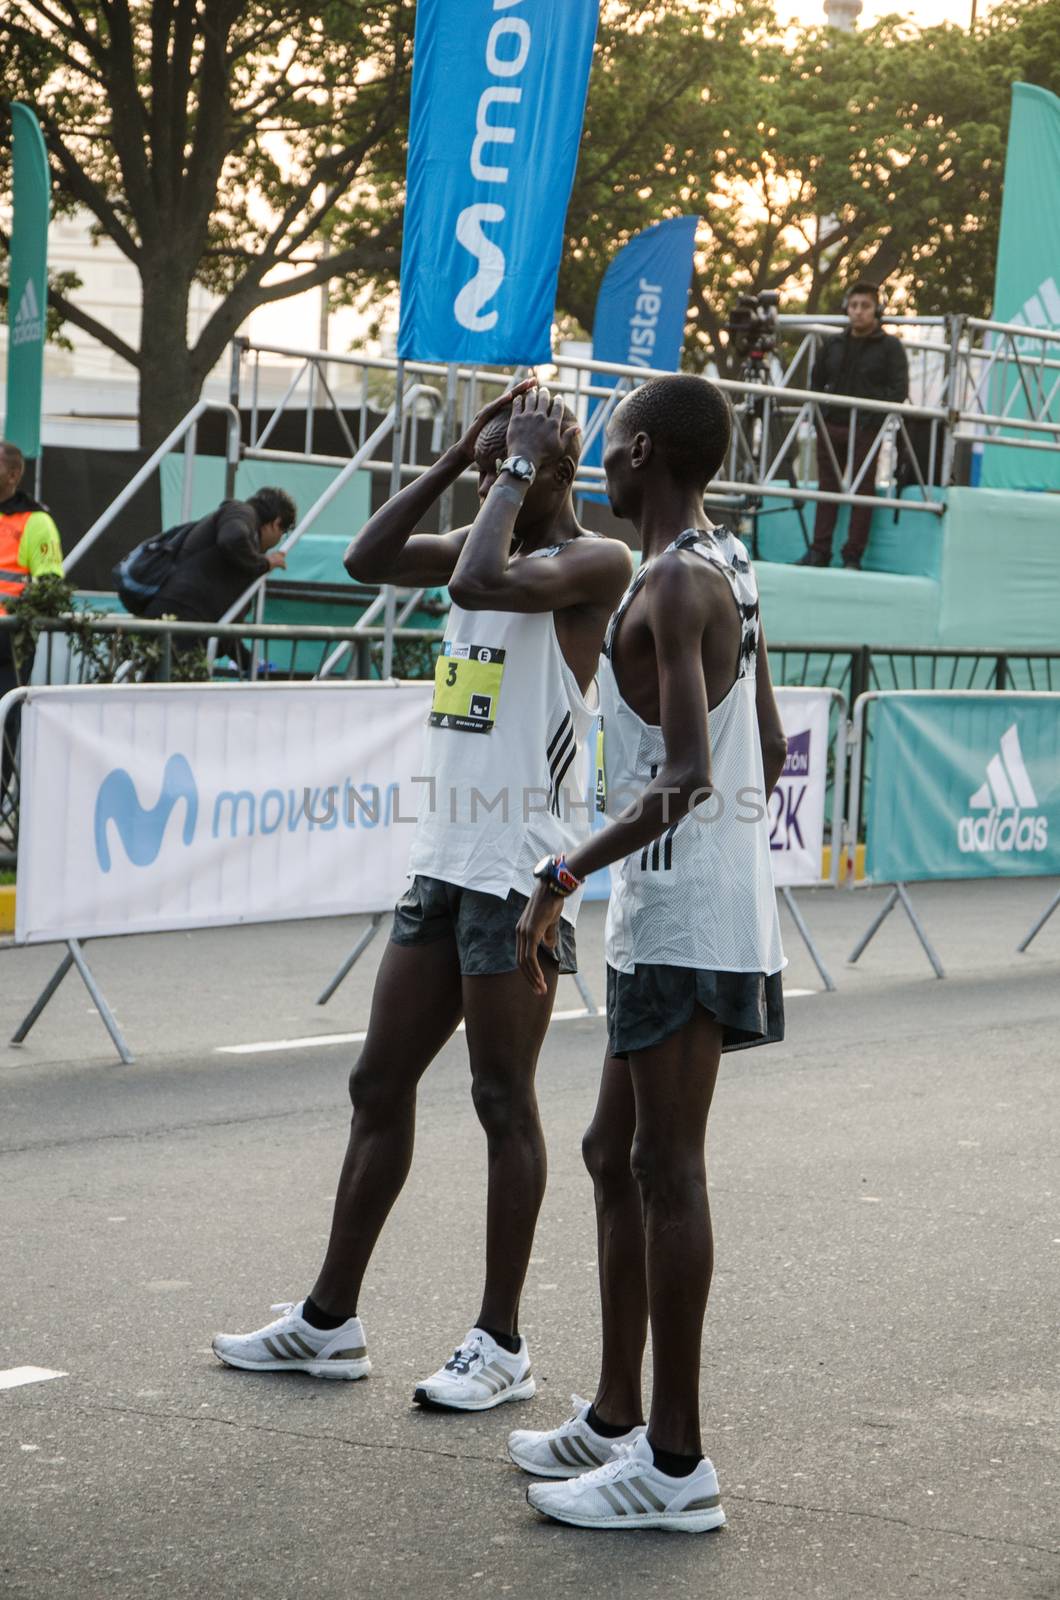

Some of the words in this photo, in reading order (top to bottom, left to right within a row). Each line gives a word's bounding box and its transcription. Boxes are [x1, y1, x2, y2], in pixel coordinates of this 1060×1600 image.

[470, 0, 531, 183] mo
[481, 650, 489, 662] E
[446, 662, 458, 687] 3
[957, 807, 1048, 853] adidas
